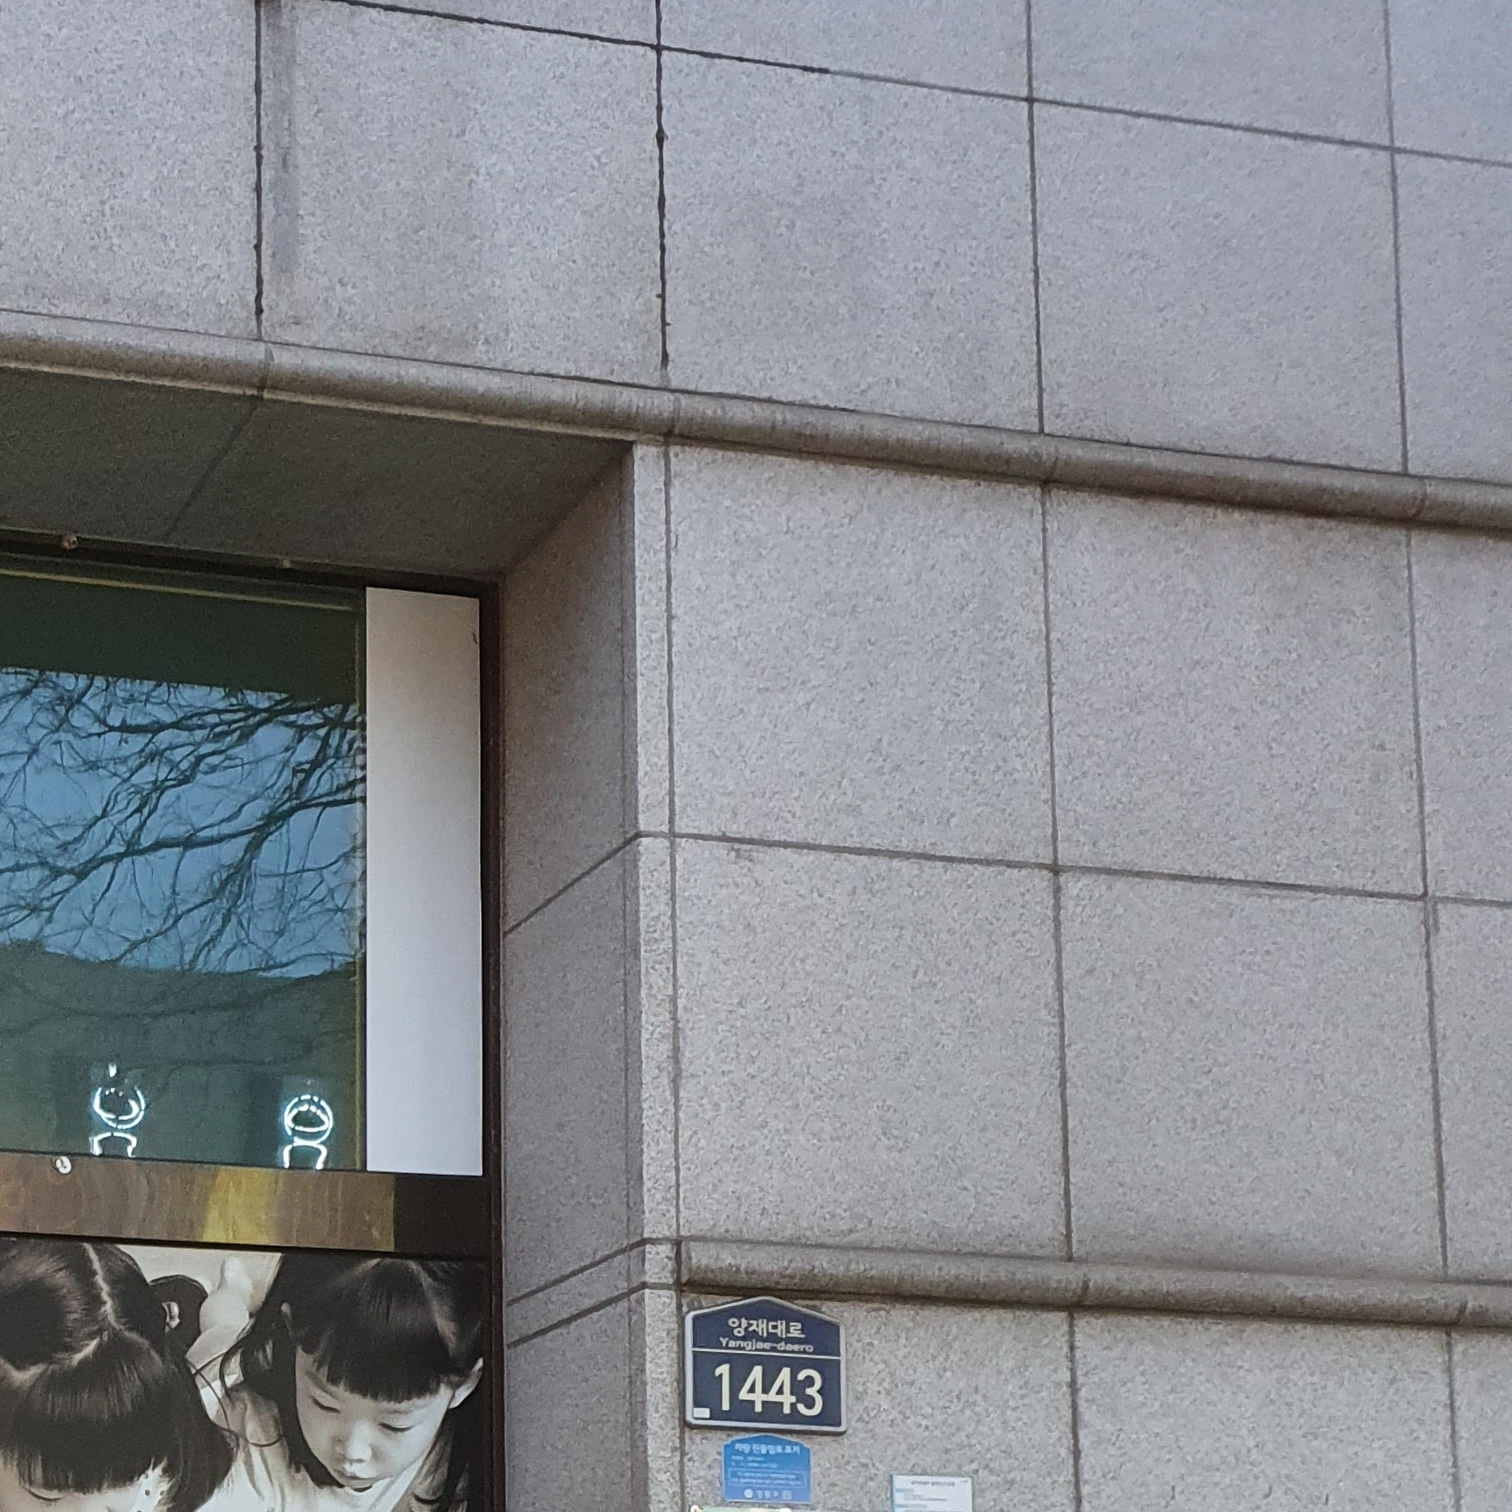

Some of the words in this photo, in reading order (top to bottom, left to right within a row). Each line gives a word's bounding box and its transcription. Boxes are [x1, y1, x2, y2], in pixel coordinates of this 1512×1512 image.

[728, 1317, 806, 1338] 양재대로
[719, 1336, 814, 1353] Yangjae-daero
[714, 1363, 823, 1417] 1443
